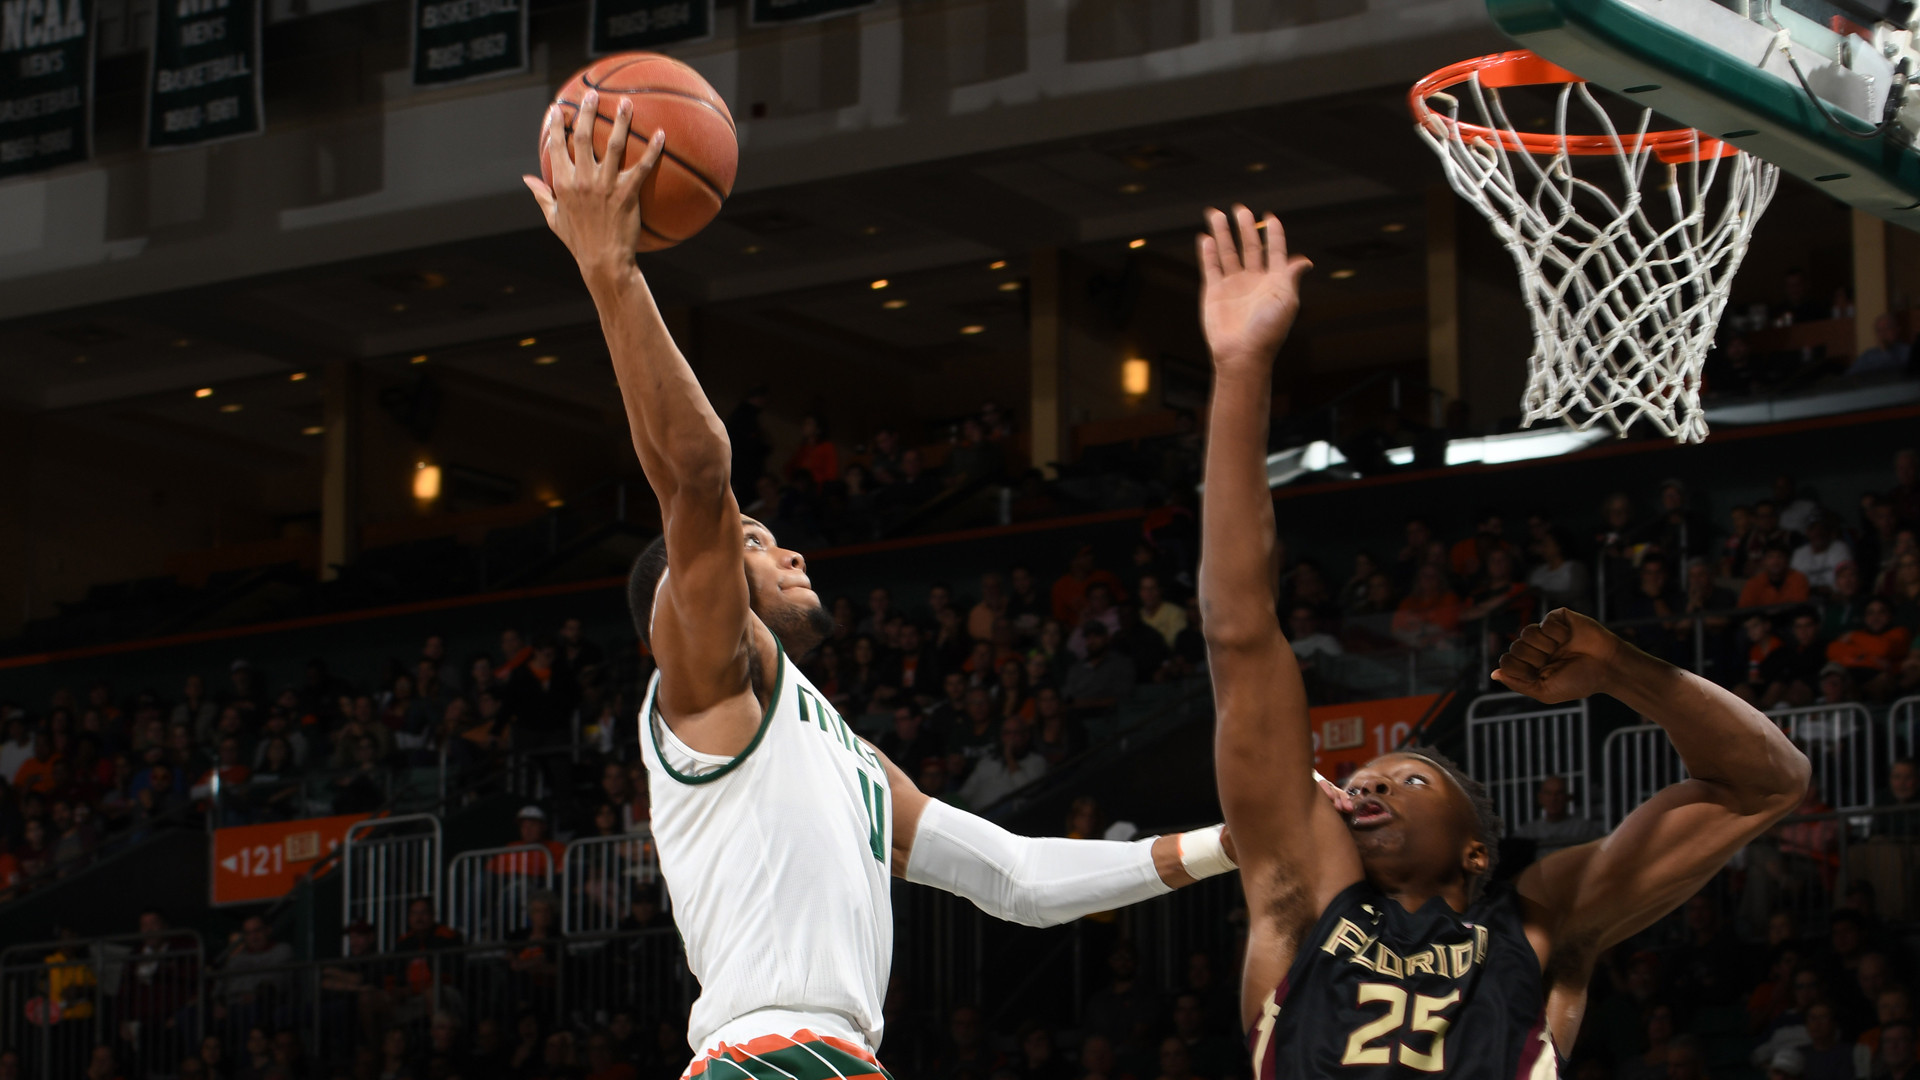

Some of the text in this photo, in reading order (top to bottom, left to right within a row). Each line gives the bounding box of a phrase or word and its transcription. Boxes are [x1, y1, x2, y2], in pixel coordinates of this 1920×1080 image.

[0, 0, 85, 52] NCAA
[239, 843, 282, 877] 121
[1340, 982, 1461, 1073] 25
